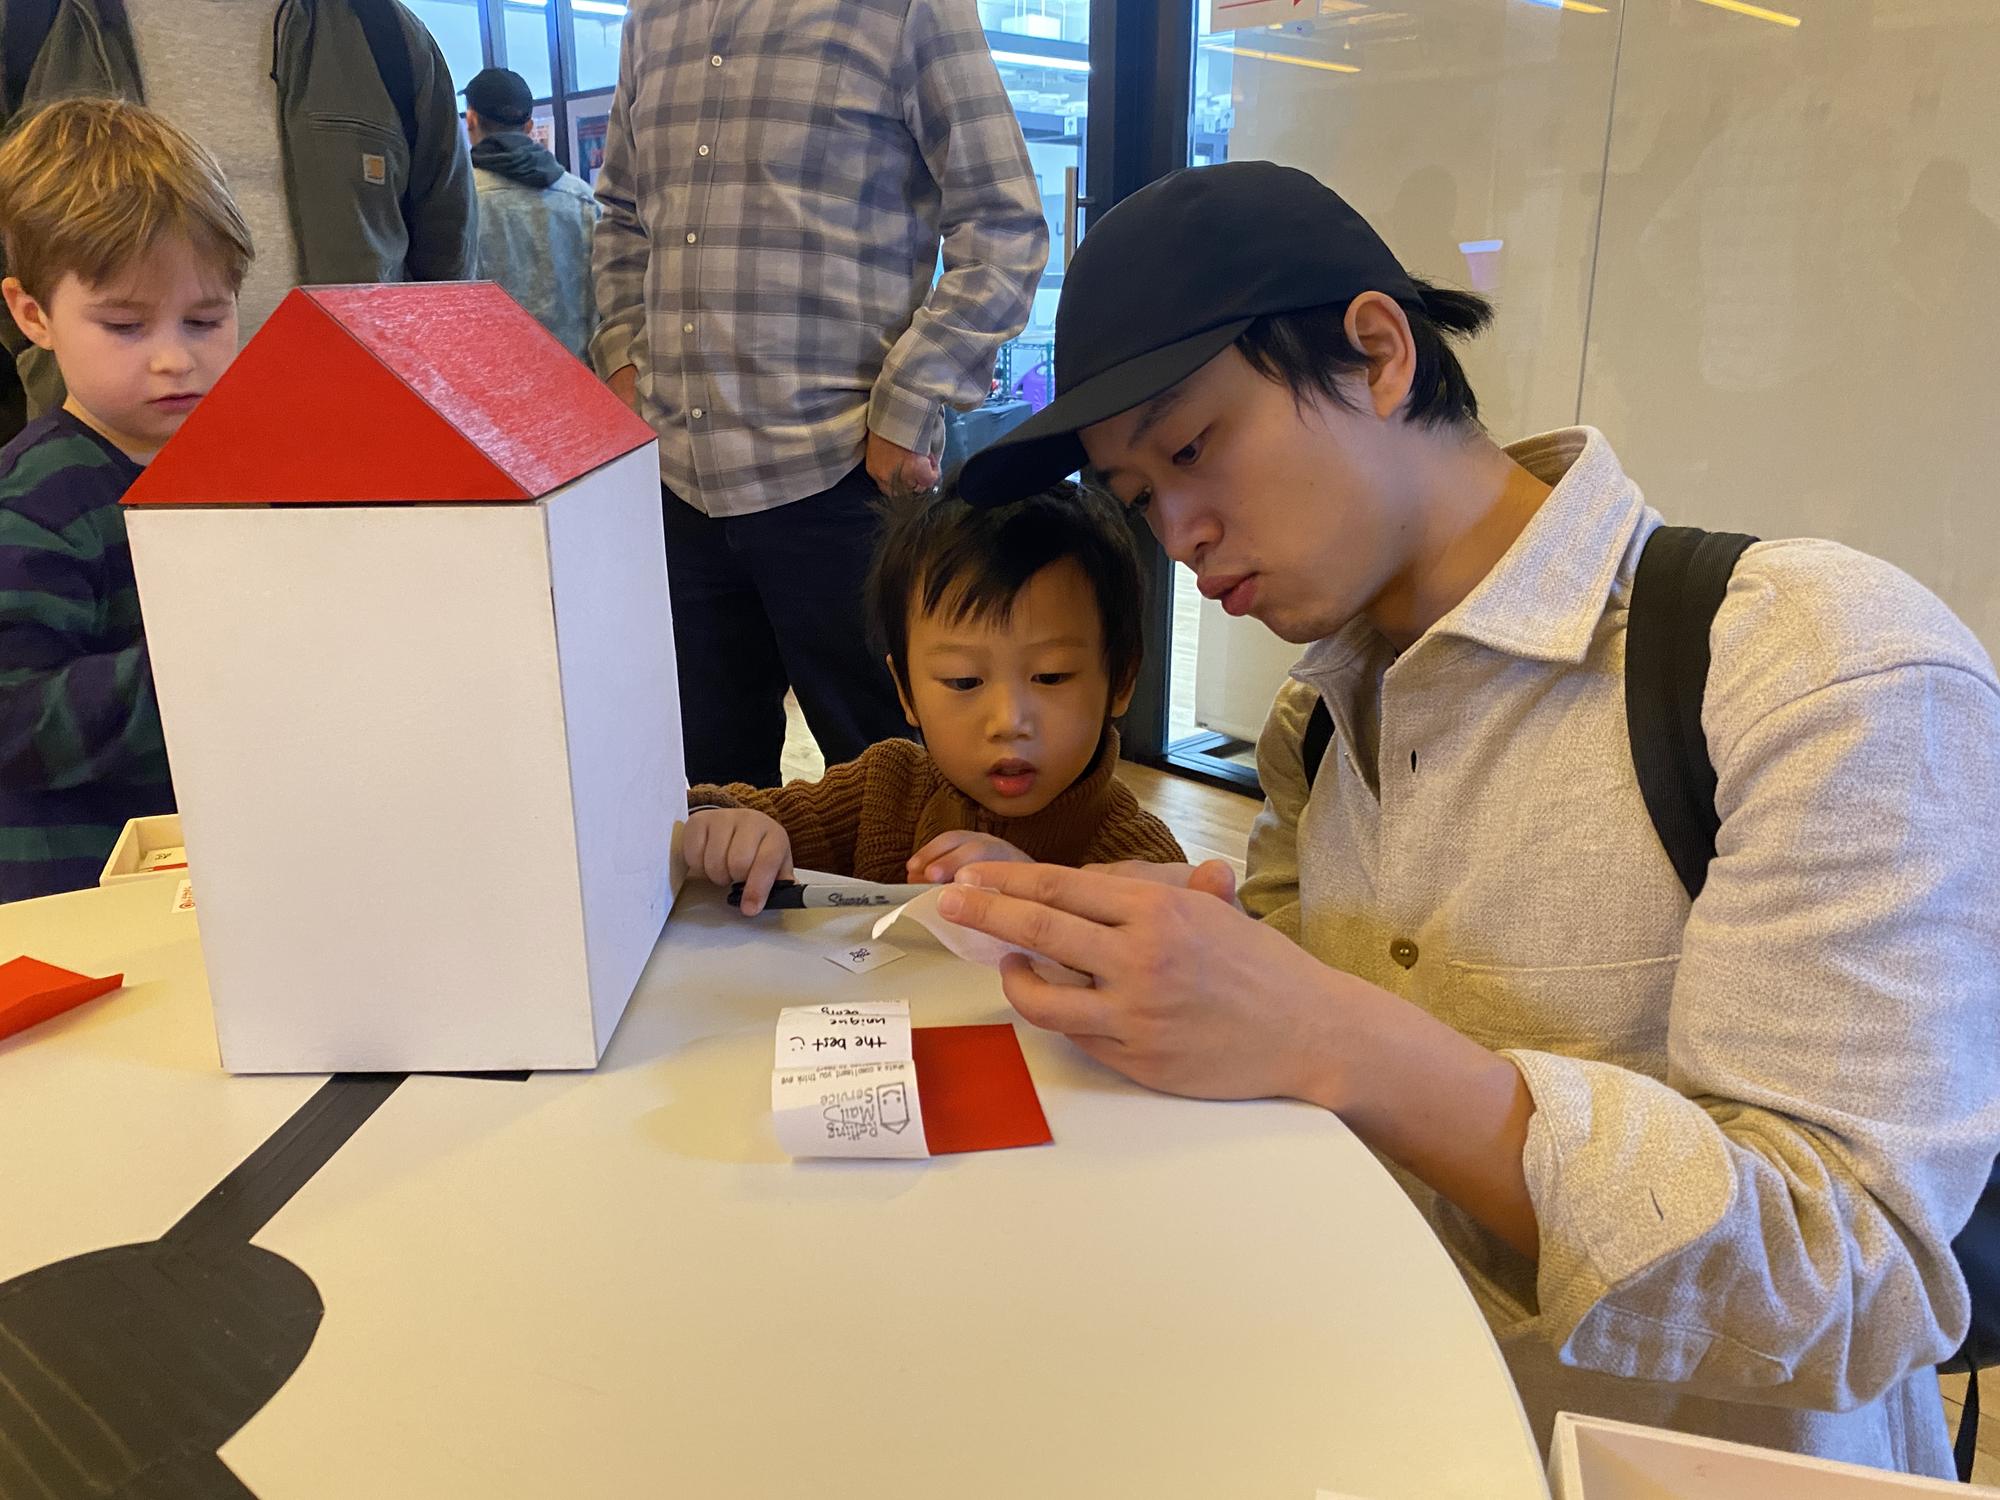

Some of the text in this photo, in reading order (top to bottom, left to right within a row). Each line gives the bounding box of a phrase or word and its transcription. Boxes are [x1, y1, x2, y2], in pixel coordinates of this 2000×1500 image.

[829, 1017, 886, 1026] unique
[812, 1035, 887, 1051] the best
[797, 1073, 816, 1084] think
[819, 1071, 832, 1079] you
[820, 1087, 874, 1105] Service
[840, 1104, 875, 1122] Mail
